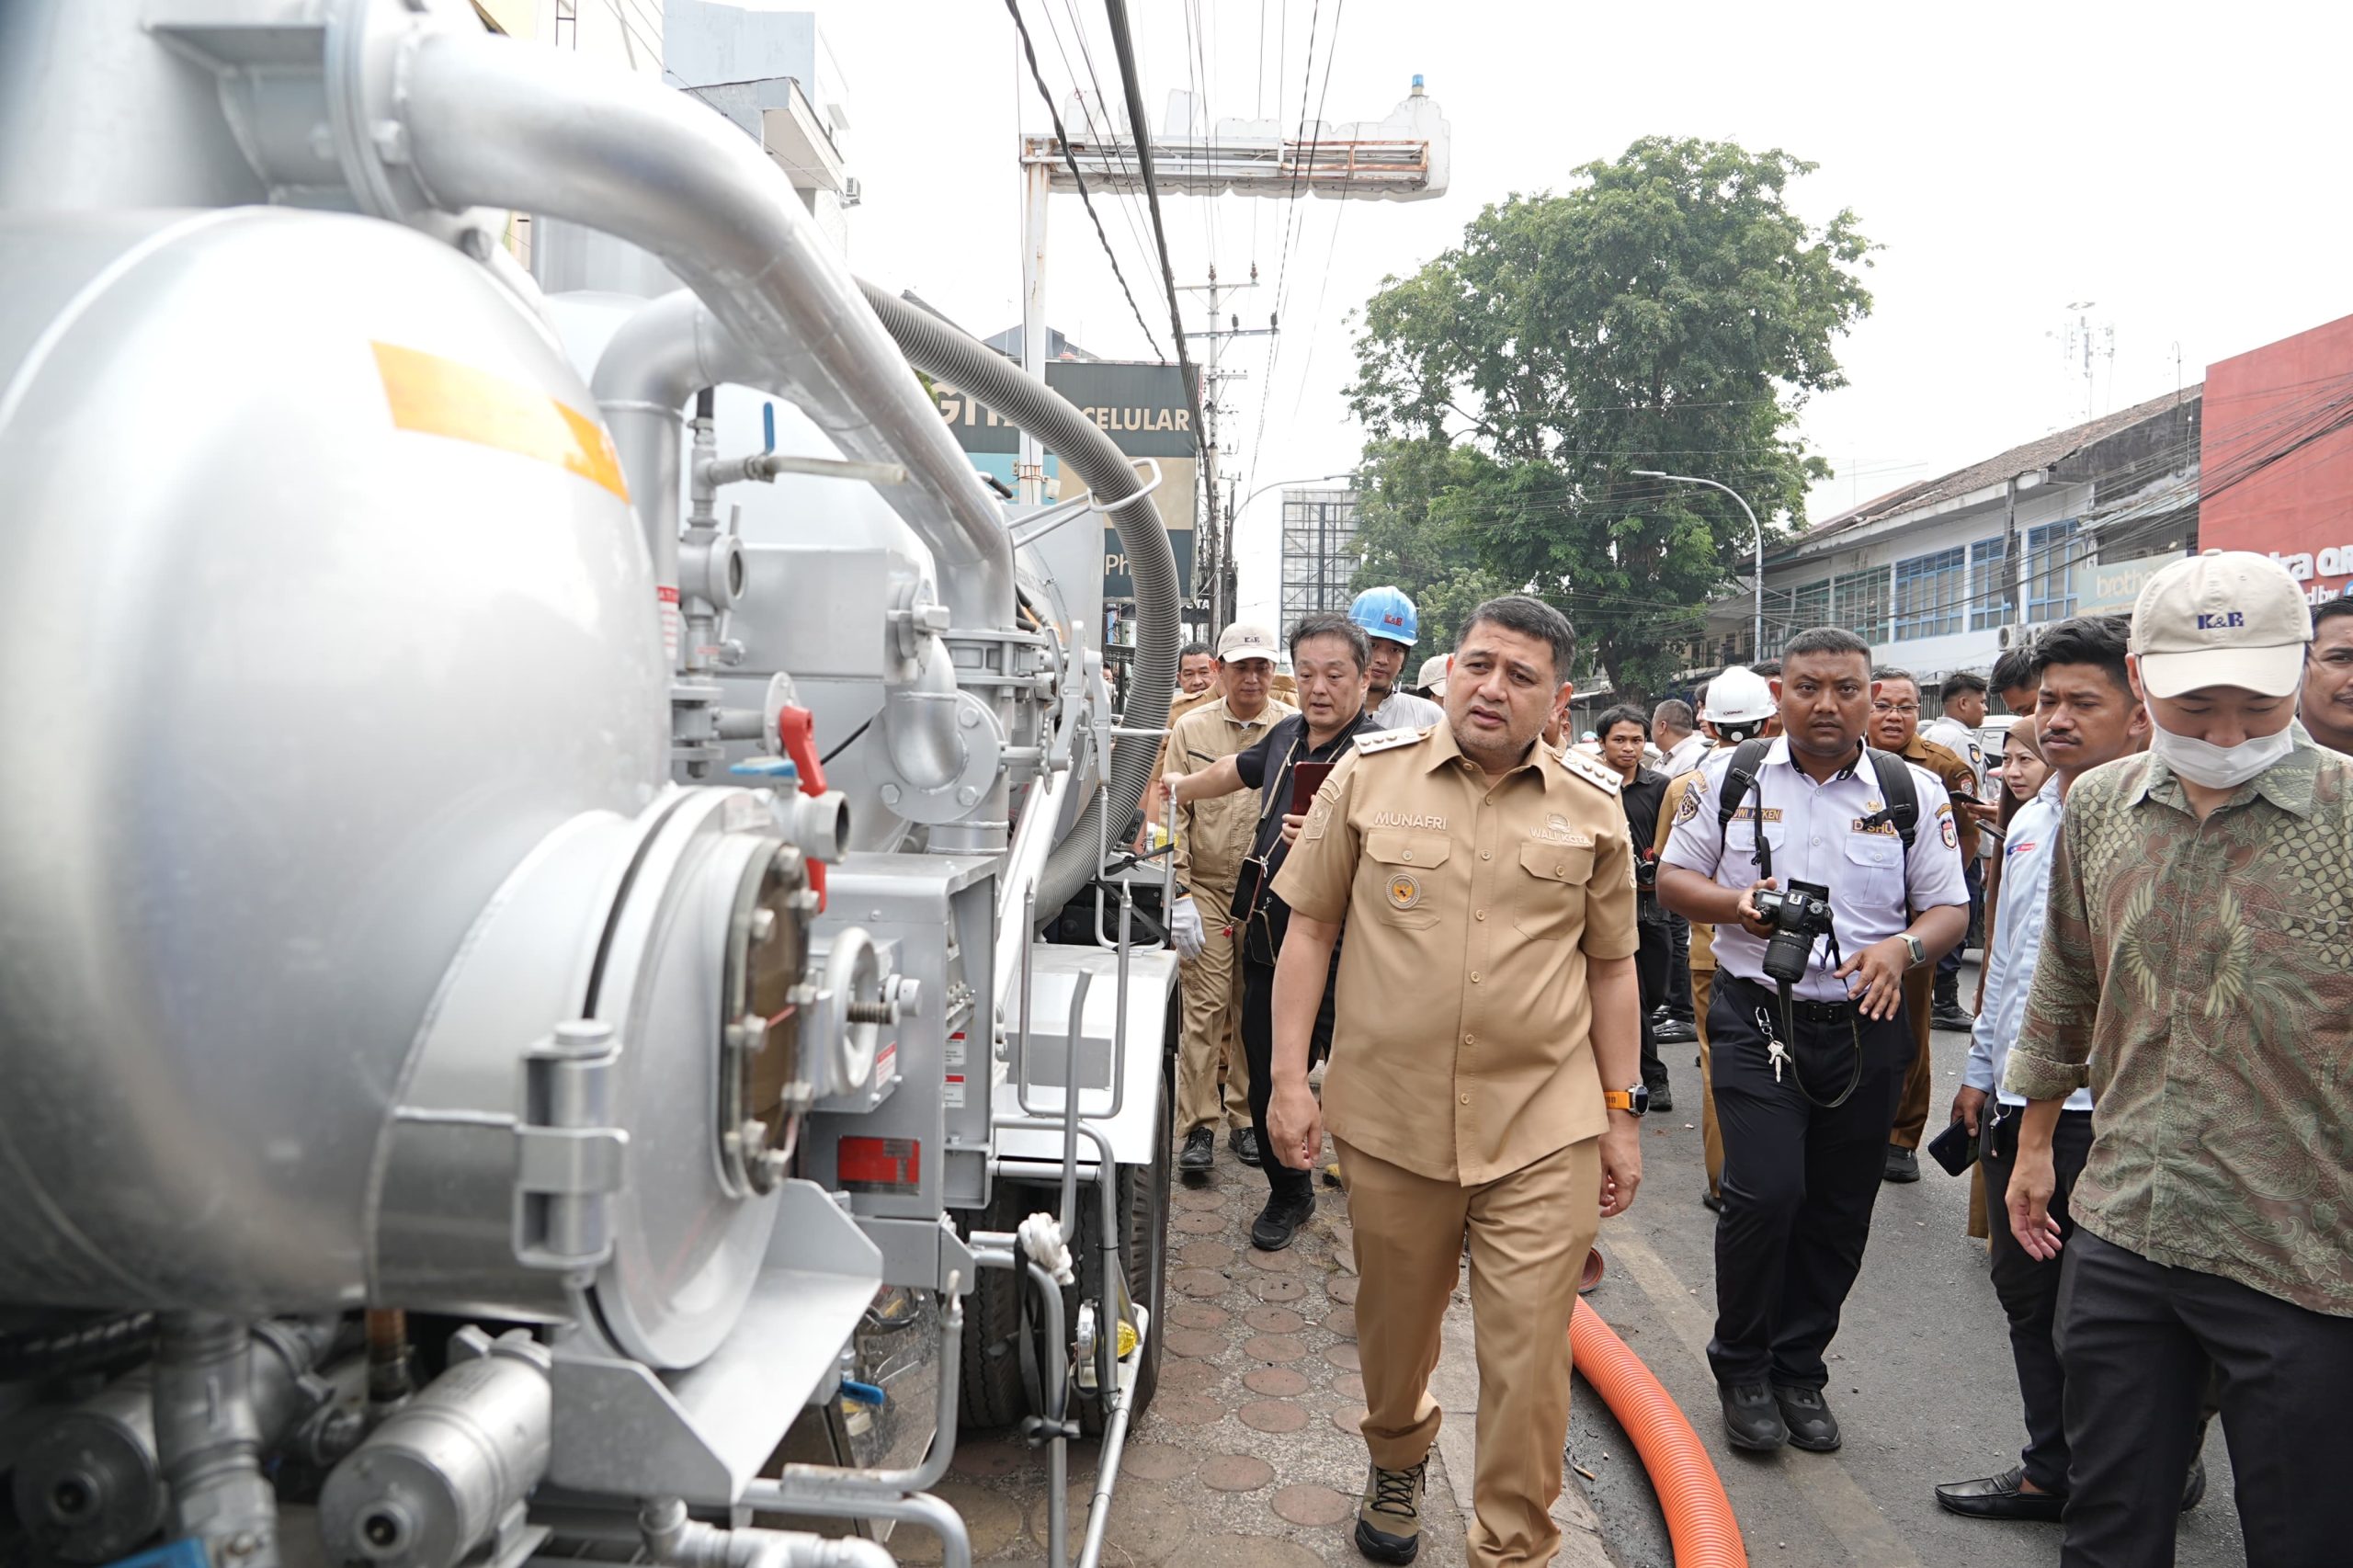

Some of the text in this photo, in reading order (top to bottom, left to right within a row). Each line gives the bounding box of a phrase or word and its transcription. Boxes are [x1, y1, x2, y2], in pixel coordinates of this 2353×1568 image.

[1375, 812, 1448, 830] MUNAFRI
[1530, 826, 1590, 845] WALI KOTA
